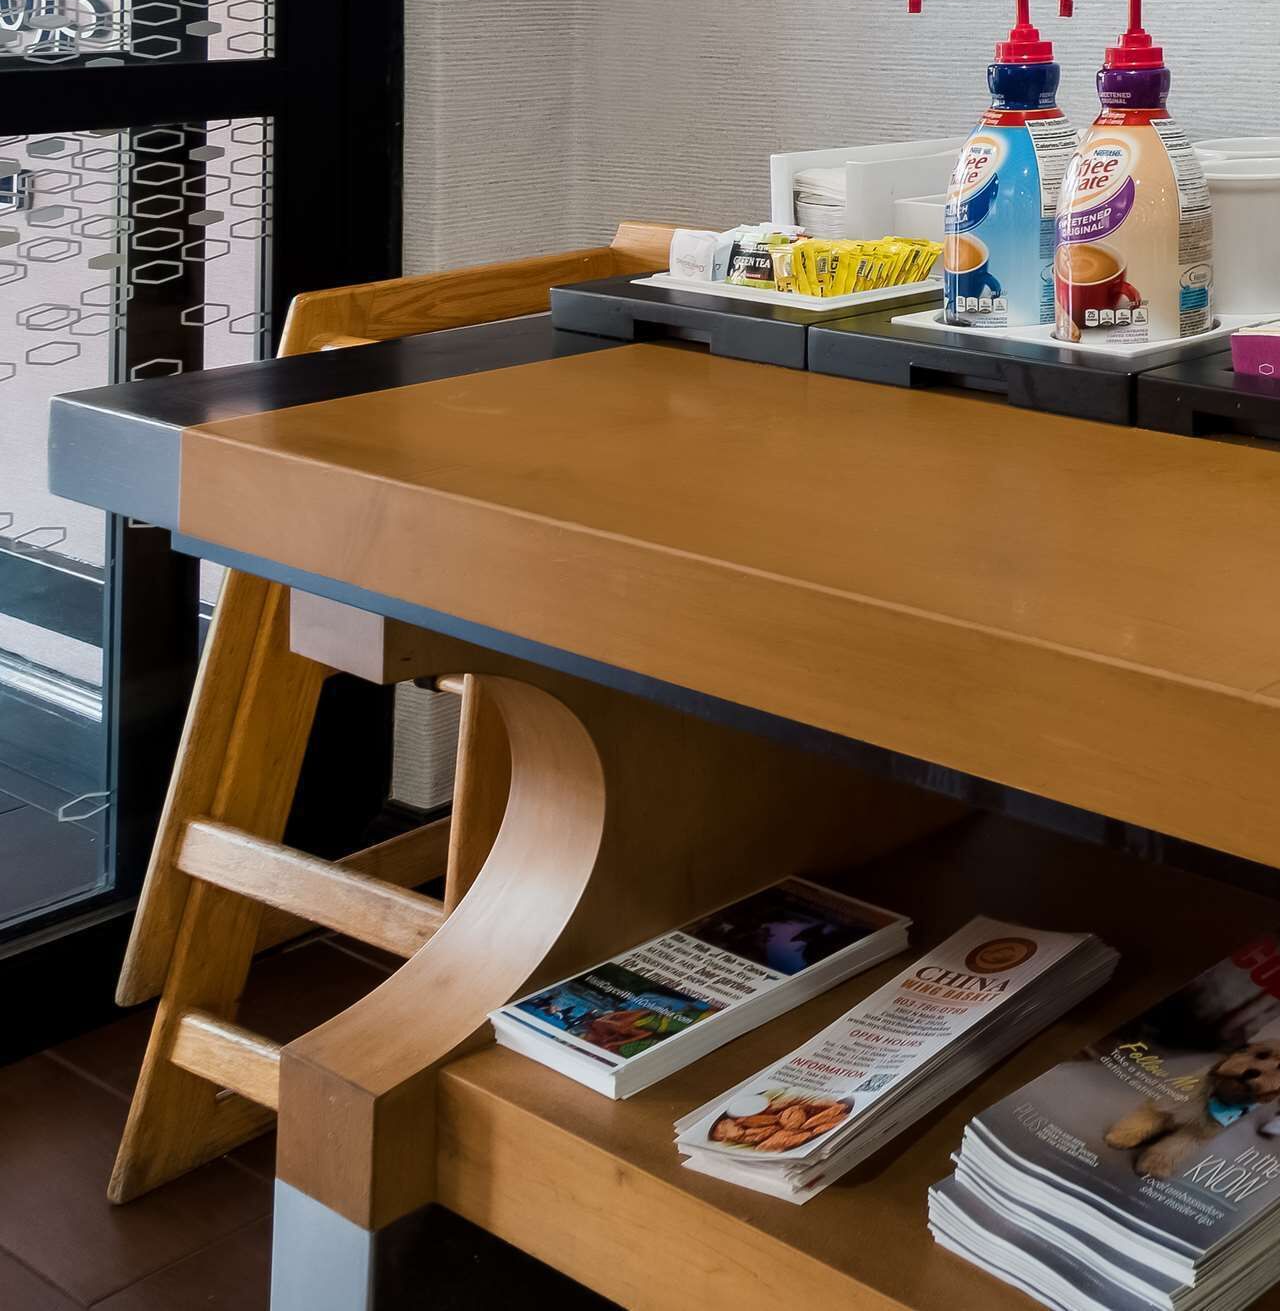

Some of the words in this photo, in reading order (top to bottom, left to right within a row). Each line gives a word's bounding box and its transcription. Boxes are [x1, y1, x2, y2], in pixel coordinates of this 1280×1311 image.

[756, 257, 771, 269] TEA
[899, 979, 941, 998] WING
[943, 988, 1003, 1002] BASKET
[915, 966, 1011, 992] CHINA
[849, 1029, 883, 1044] OPEN
[884, 1036, 925, 1048] HOURS
[790, 1056, 866, 1080] INFORMATION
[1099, 1055, 1129, 1083] distinct
[1110, 1048, 1129, 1068] Take
[1135, 1068, 1156, 1087] stroll
[1156, 1080, 1190, 1103] through
[1118, 1040, 1169, 1078] Follow
[1165, 1074, 1200, 1091] Me
[1012, 1102, 1049, 1133] PLUS
[1183, 1154, 1272, 1203] KNOW
[1139, 1185, 1166, 1201] share
[1164, 1199, 1196, 1220] insider
[1195, 1214, 1216, 1227] tips
[1141, 1173, 1168, 1190] Local
[1166, 1183, 1225, 1220] ambassadors
